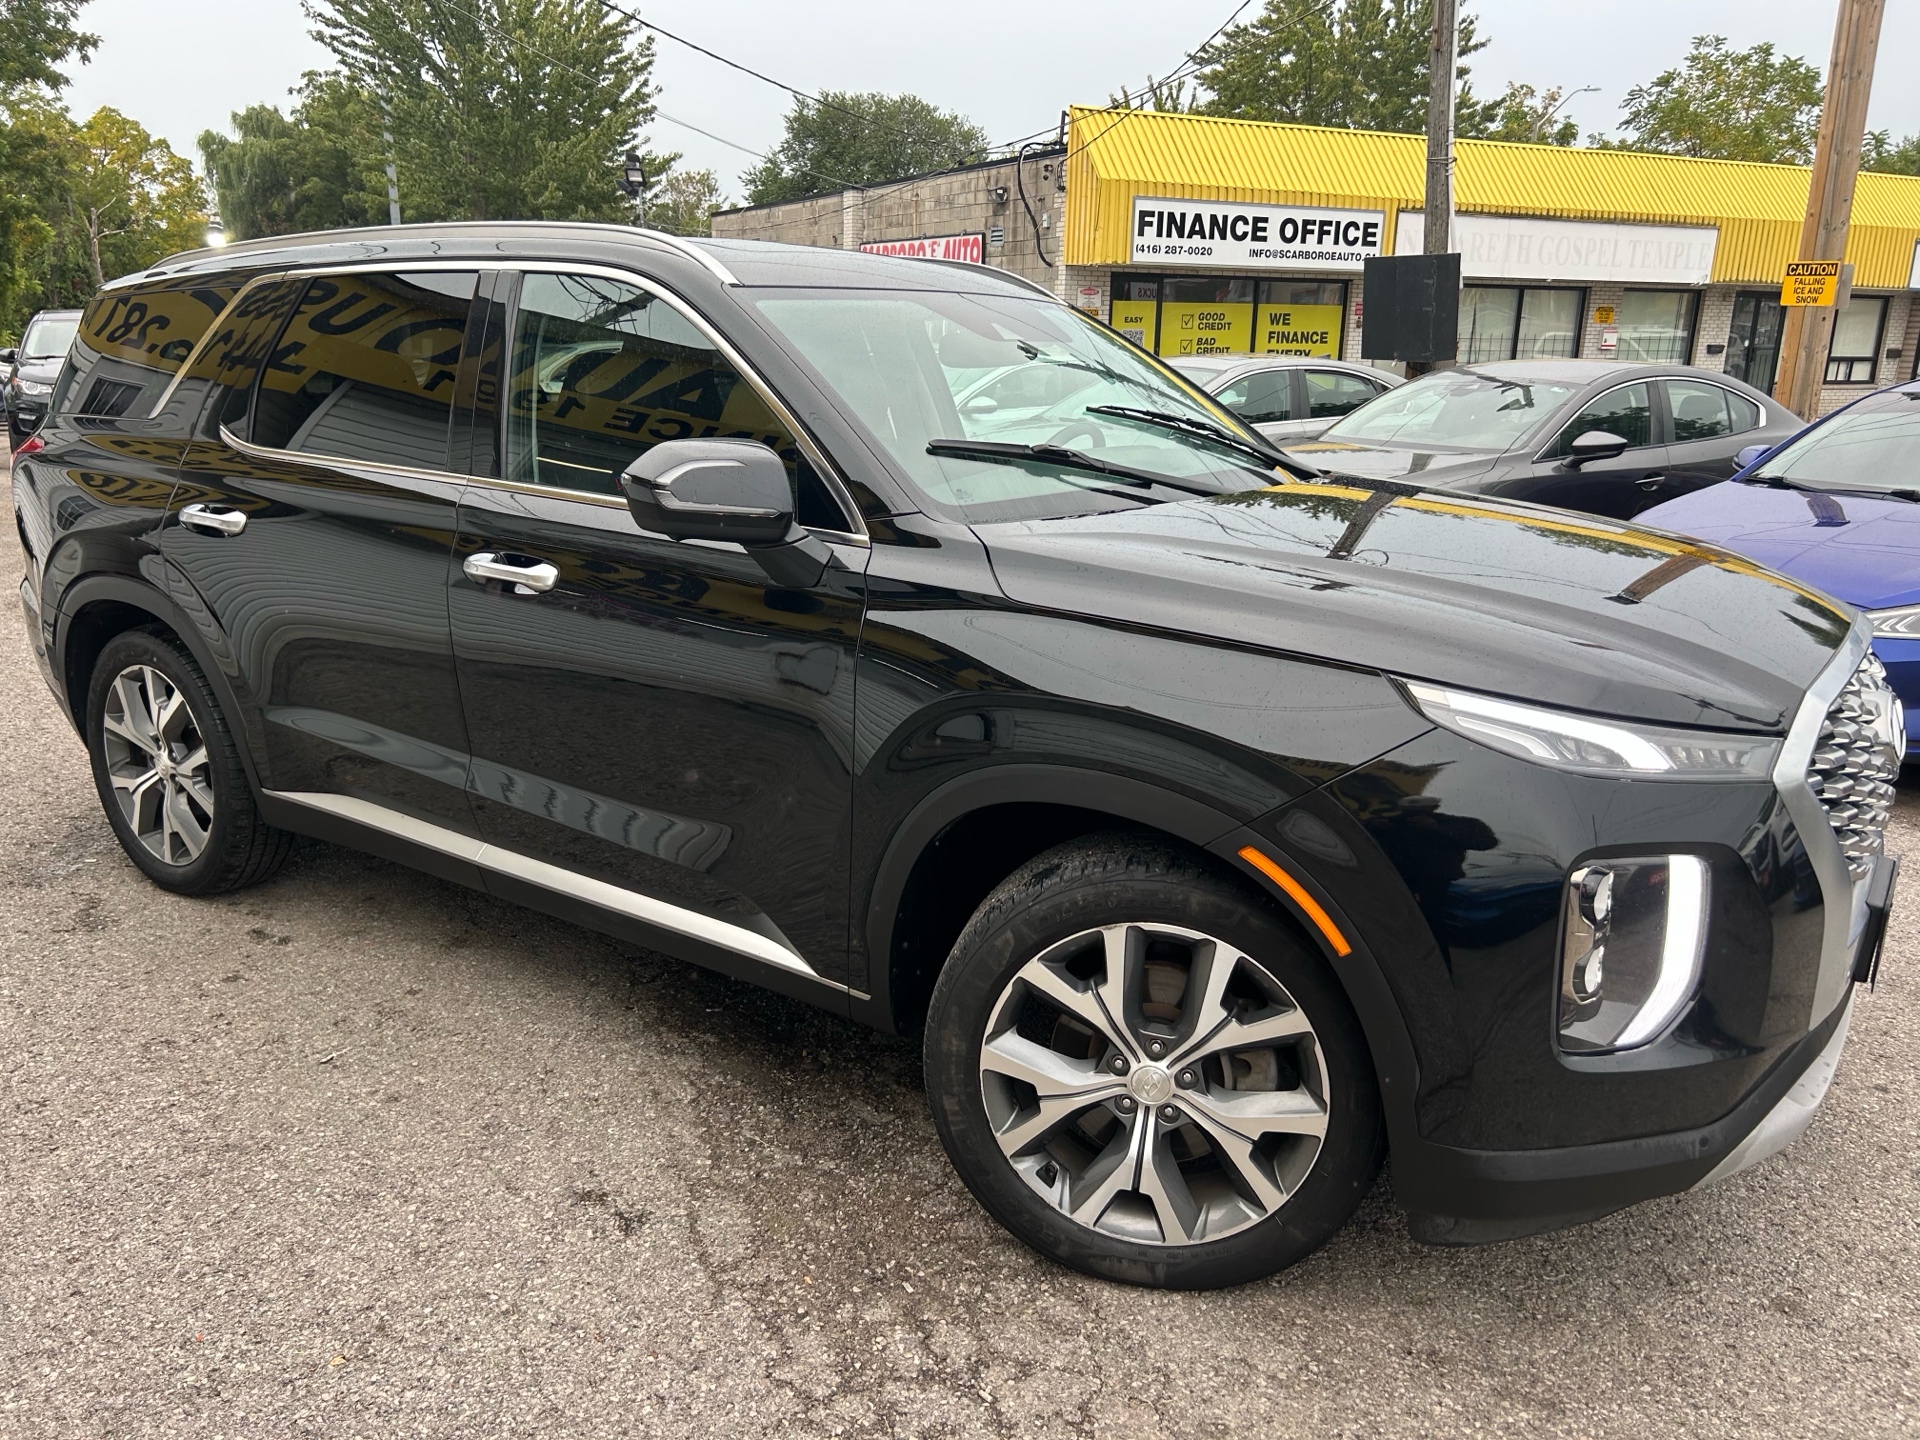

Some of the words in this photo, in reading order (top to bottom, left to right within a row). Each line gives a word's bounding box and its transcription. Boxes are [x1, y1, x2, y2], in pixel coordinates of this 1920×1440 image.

[1137, 209, 1269, 243] FINANCE
[1279, 217, 1379, 248] OFFICE
[943, 236, 981, 264] AUTO
[1136, 243, 1162, 255] (416)
[1164, 245, 1213, 256] 287-0020
[1538, 235, 1623, 268] GOSPEL
[1628, 239, 1711, 271] TEMPLE
[1788, 264, 1836, 275] CAUTION
[1793, 277, 1826, 286] FALLING
[1793, 286, 1806, 295] ICE
[1807, 286, 1824, 295] AND
[1795, 295, 1819, 304] SNOW
[1124, 316, 1144, 324] EASY
[1198, 312, 1226, 321] GOOD
[1269, 312, 1291, 326] WE
[1197, 321, 1232, 331] CREDIT
[1196, 337, 1216, 346] BAD
[1267, 331, 1329, 345] FINANCE
[1196, 346, 1231, 355] CREDIT
